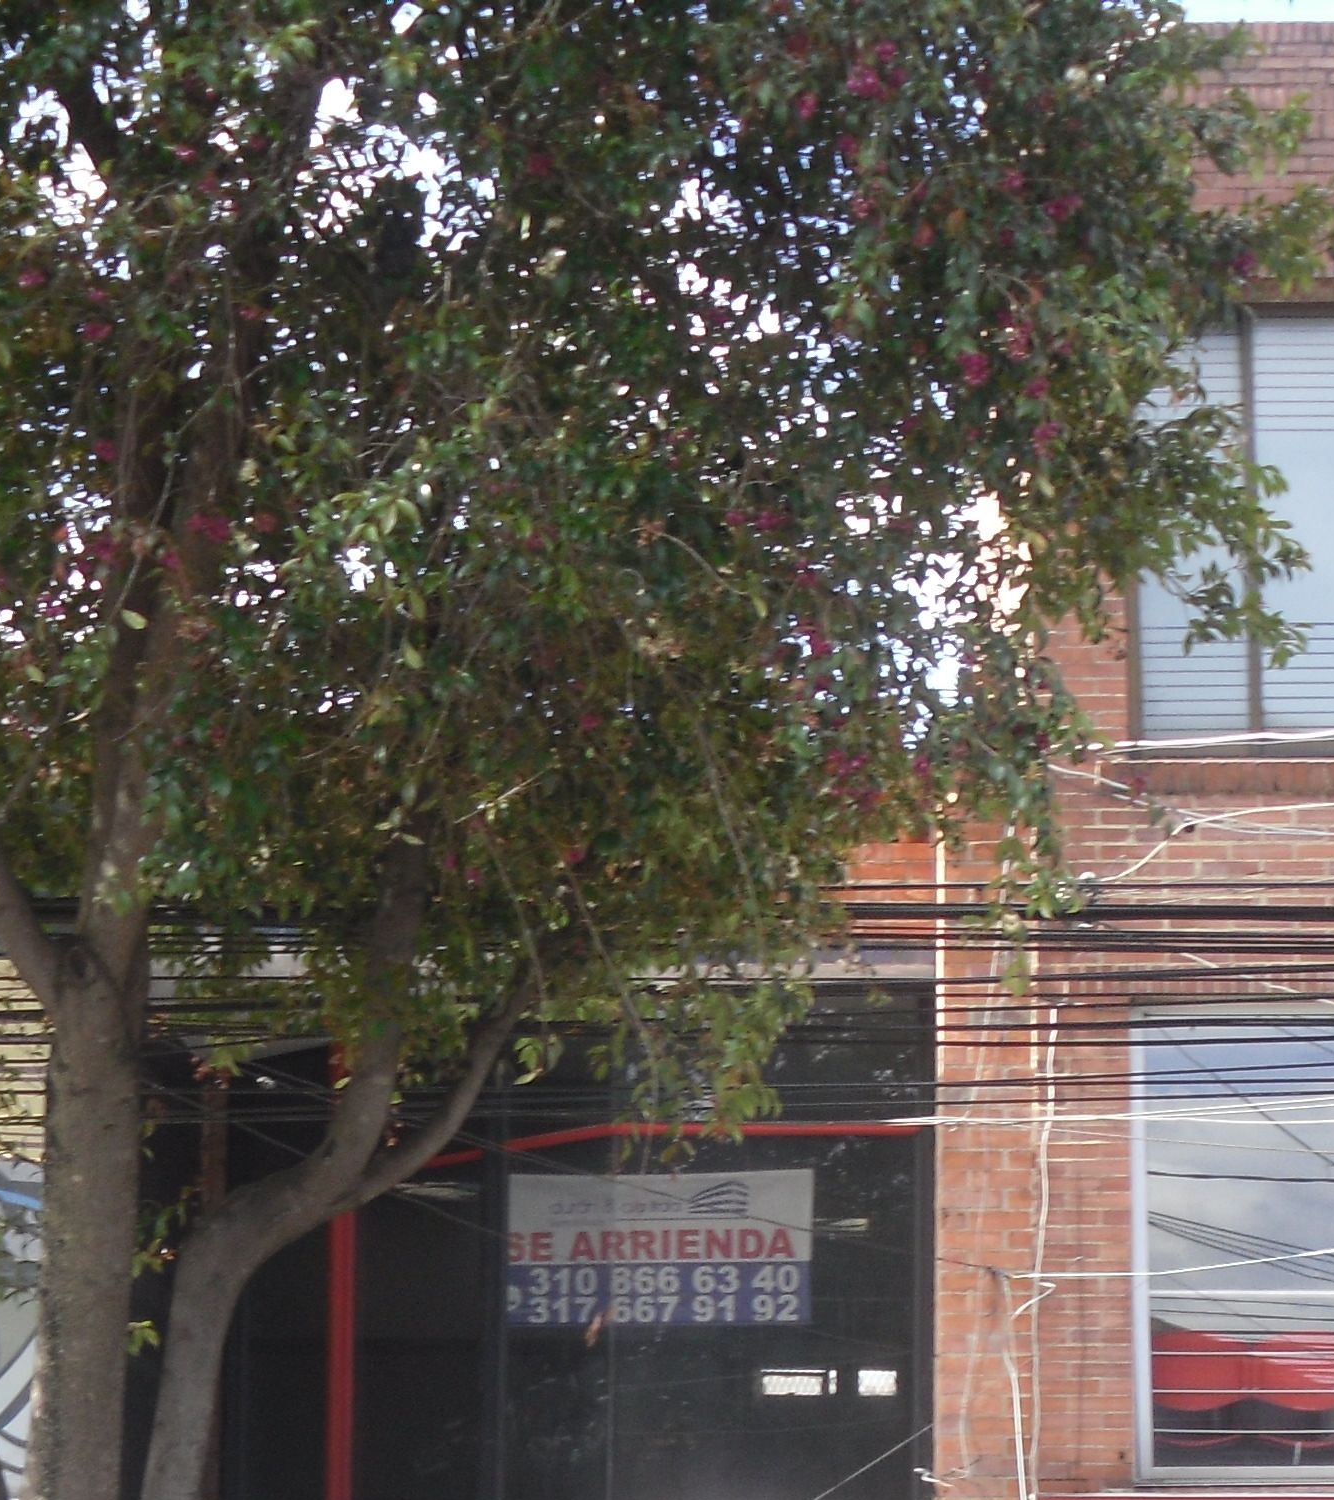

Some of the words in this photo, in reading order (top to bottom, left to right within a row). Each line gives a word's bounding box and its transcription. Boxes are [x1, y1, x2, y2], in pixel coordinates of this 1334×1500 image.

[571, 1228, 796, 1261] ARRIENDA
[529, 1268, 597, 1295] 310
[692, 1266, 739, 1293] 63
[752, 1265, 799, 1292] 40
[528, 1296, 597, 1323] 317
[692, 1295, 737, 1322] 91
[752, 1295, 799, 1321] 92
